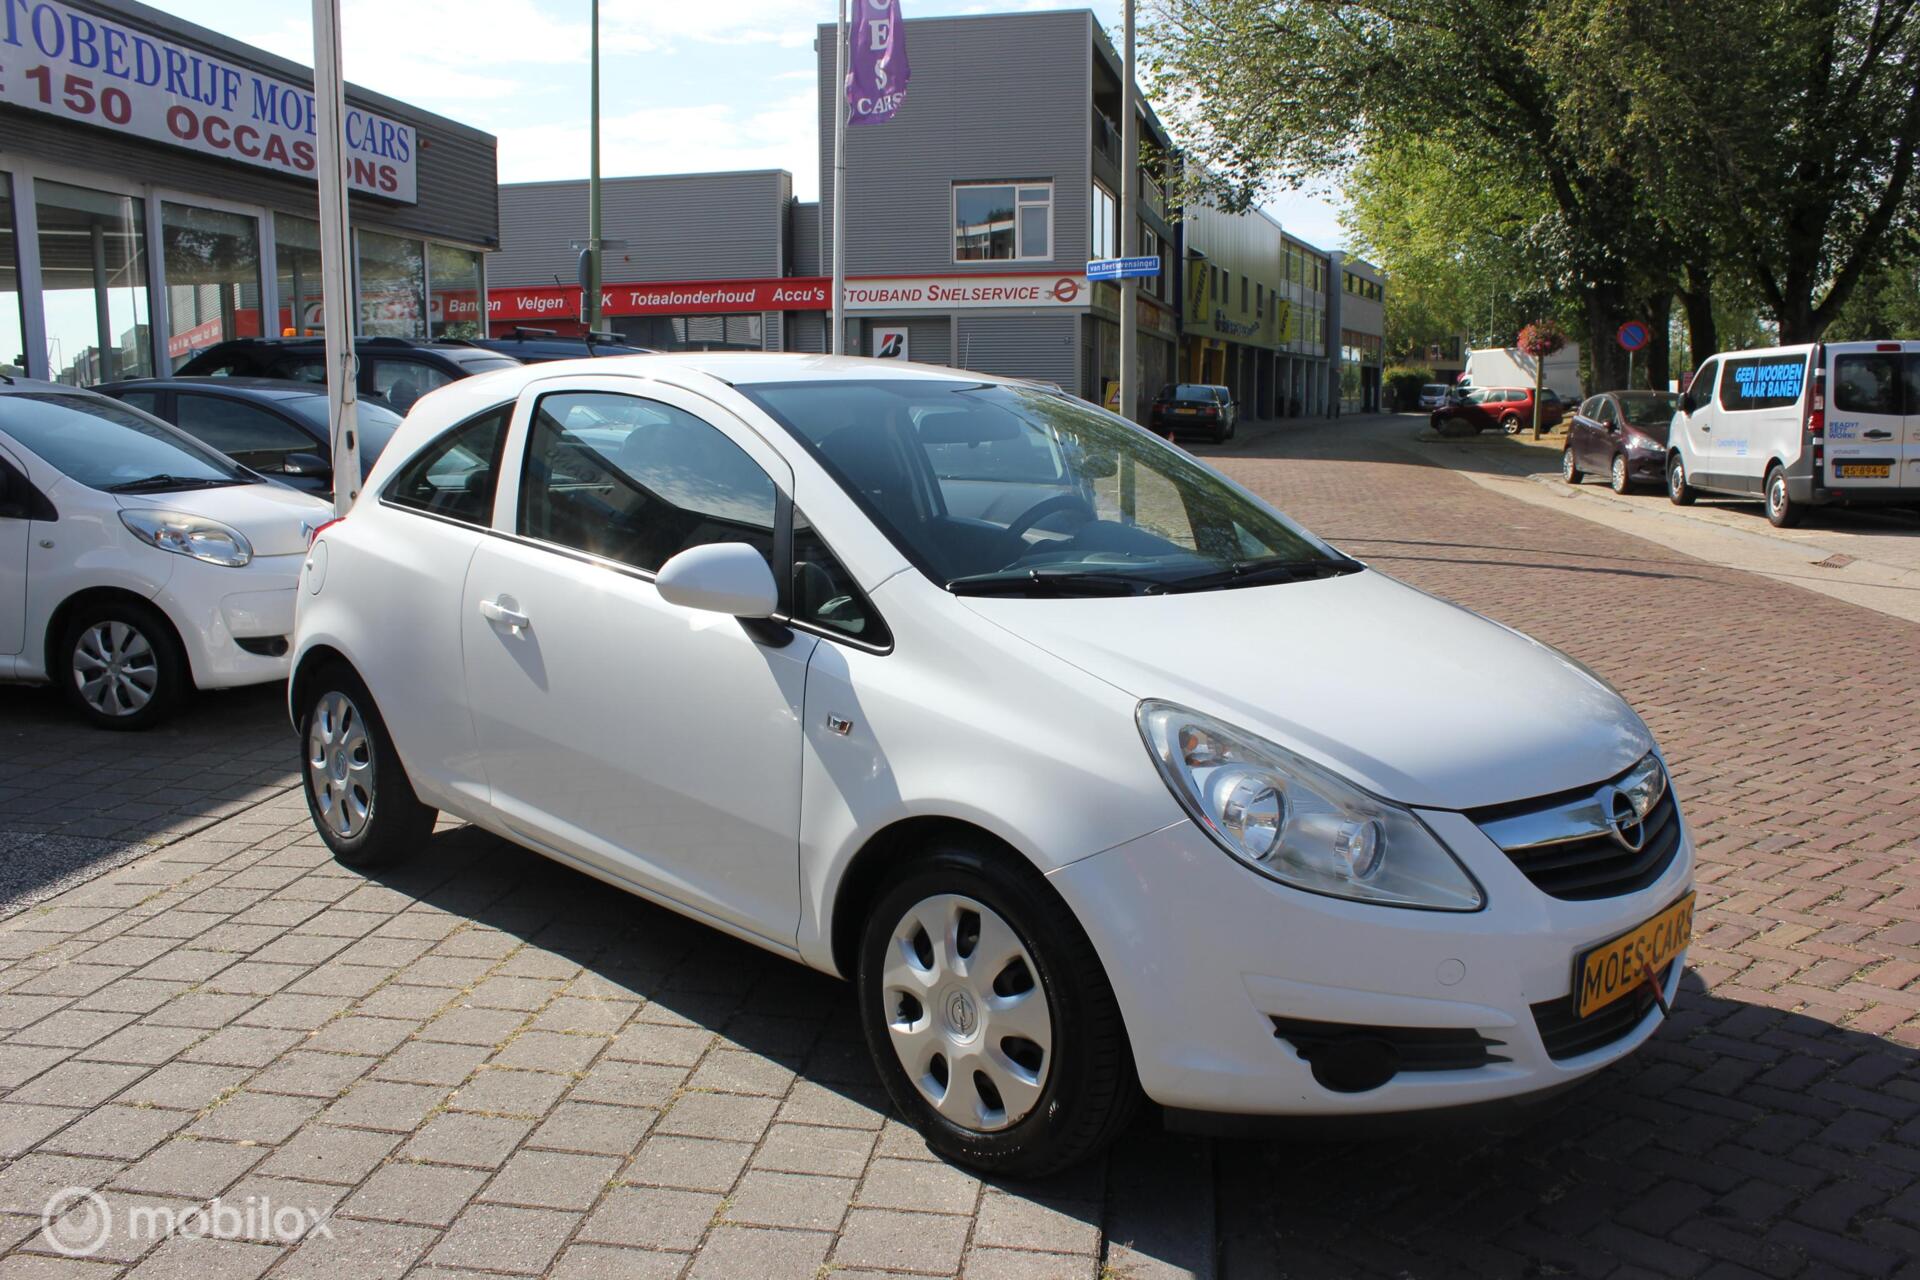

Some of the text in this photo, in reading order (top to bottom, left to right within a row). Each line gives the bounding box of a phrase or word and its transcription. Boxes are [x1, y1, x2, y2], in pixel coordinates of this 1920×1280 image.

[857, 92, 903, 114] CARS
[25, 64, 398, 193] 150 OCCASNS
[252, 77, 317, 137] MOE
[346, 111, 410, 163] CARS
[1102, 259, 1156, 271] Beetvensingel
[630, 289, 756, 306] Totaalonderhoud
[772, 287, 825, 302] Accu's
[927, 285, 1040, 302] SNELSERVICE
[516, 297, 563, 312] Velgen
[1735, 363, 1803, 382] GEEN WOORDEN
[1741, 380, 1801, 398] MAAR BANEN
[1583, 904, 1695, 1007] MOES-CARS
